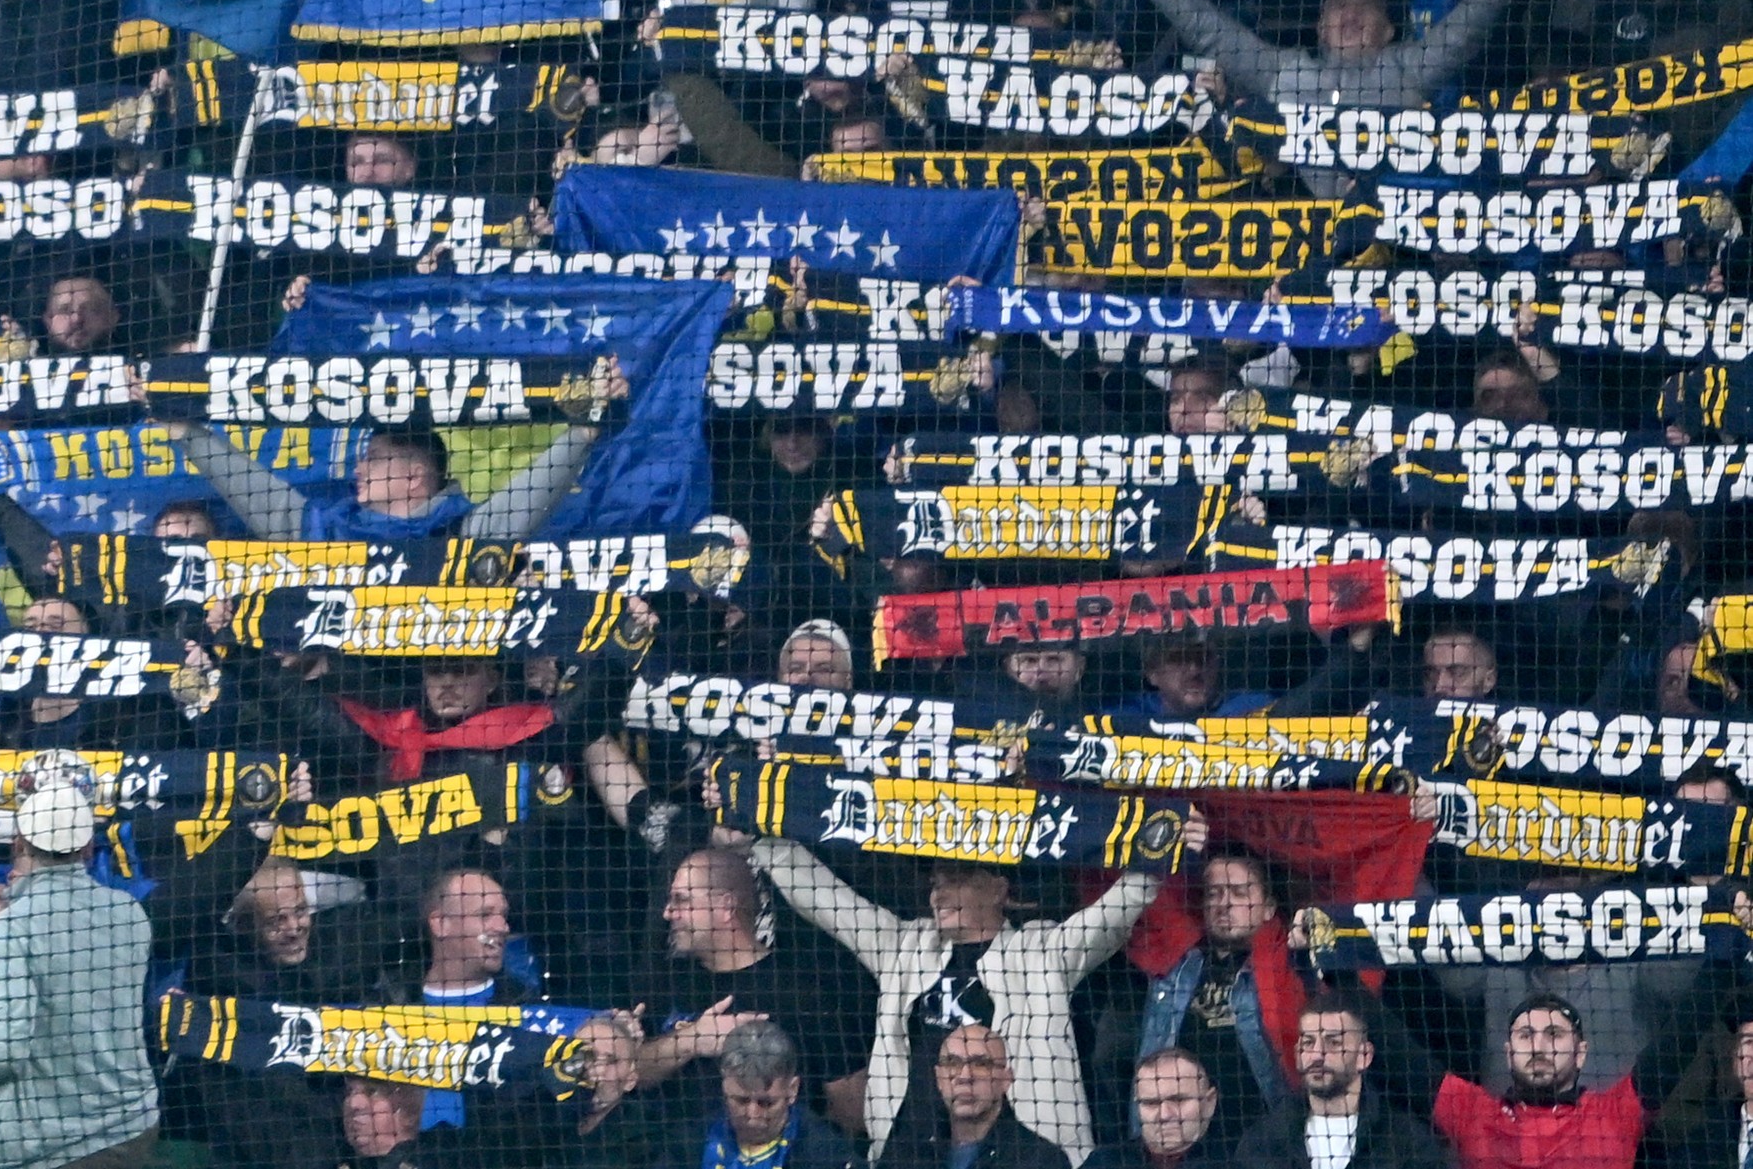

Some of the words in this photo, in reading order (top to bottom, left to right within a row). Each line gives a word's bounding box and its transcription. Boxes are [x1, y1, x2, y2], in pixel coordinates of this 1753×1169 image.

[1277, 102, 1598, 175] KOSOVA
[1374, 179, 1683, 253] KOSOVA
[998, 287, 1296, 338] KOSOVA
[203, 356, 532, 422] KOSOVA
[968, 434, 1298, 492] KOSOVA
[896, 488, 1162, 558] Dardanët
[296, 587, 559, 656] Dardanët
[986, 582, 1290, 645] ALBANIA
[622, 672, 954, 742] KOSOVA
[819, 772, 1079, 863] Dardanët
[1431, 774, 1693, 870] Dardanët
[1354, 884, 1708, 965] KOSOVA
[264, 1003, 516, 1088] Dardanët
